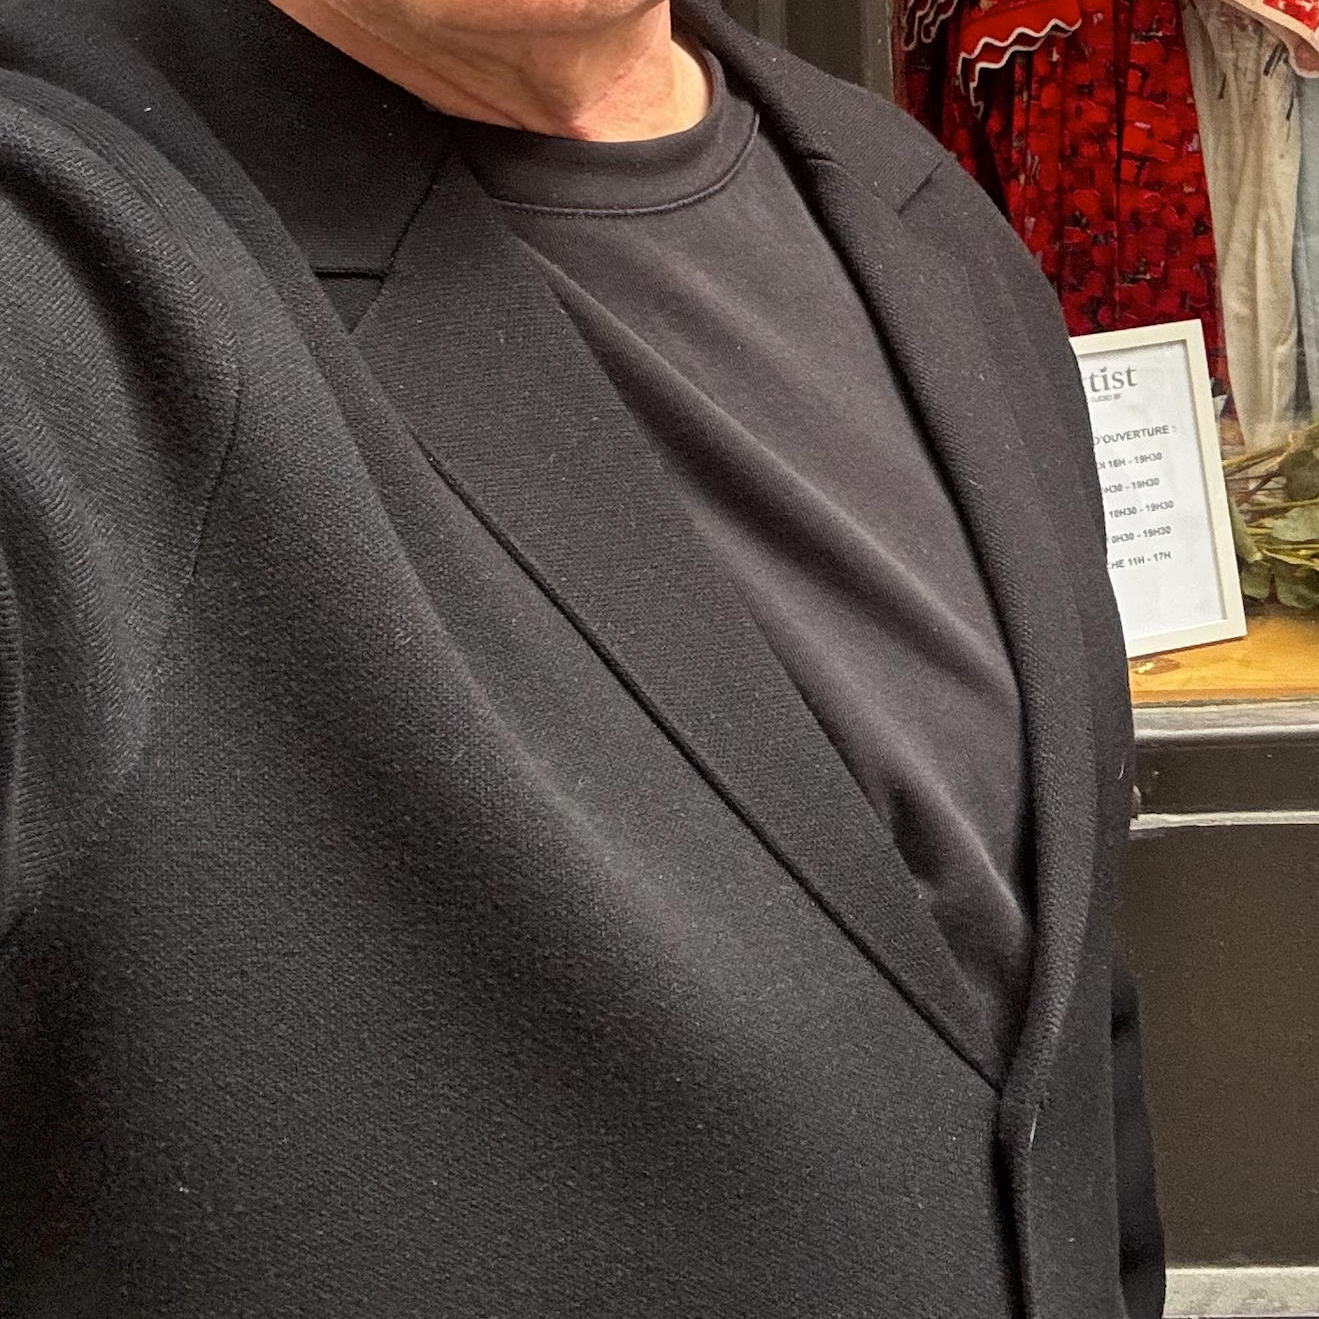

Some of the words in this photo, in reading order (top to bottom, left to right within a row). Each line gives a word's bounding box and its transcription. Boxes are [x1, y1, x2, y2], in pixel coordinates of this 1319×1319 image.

[1084, 365, 1139, 393] tist
[1127, 556, 1145, 567] 11H
[1153, 551, 1172, 562] 17H
